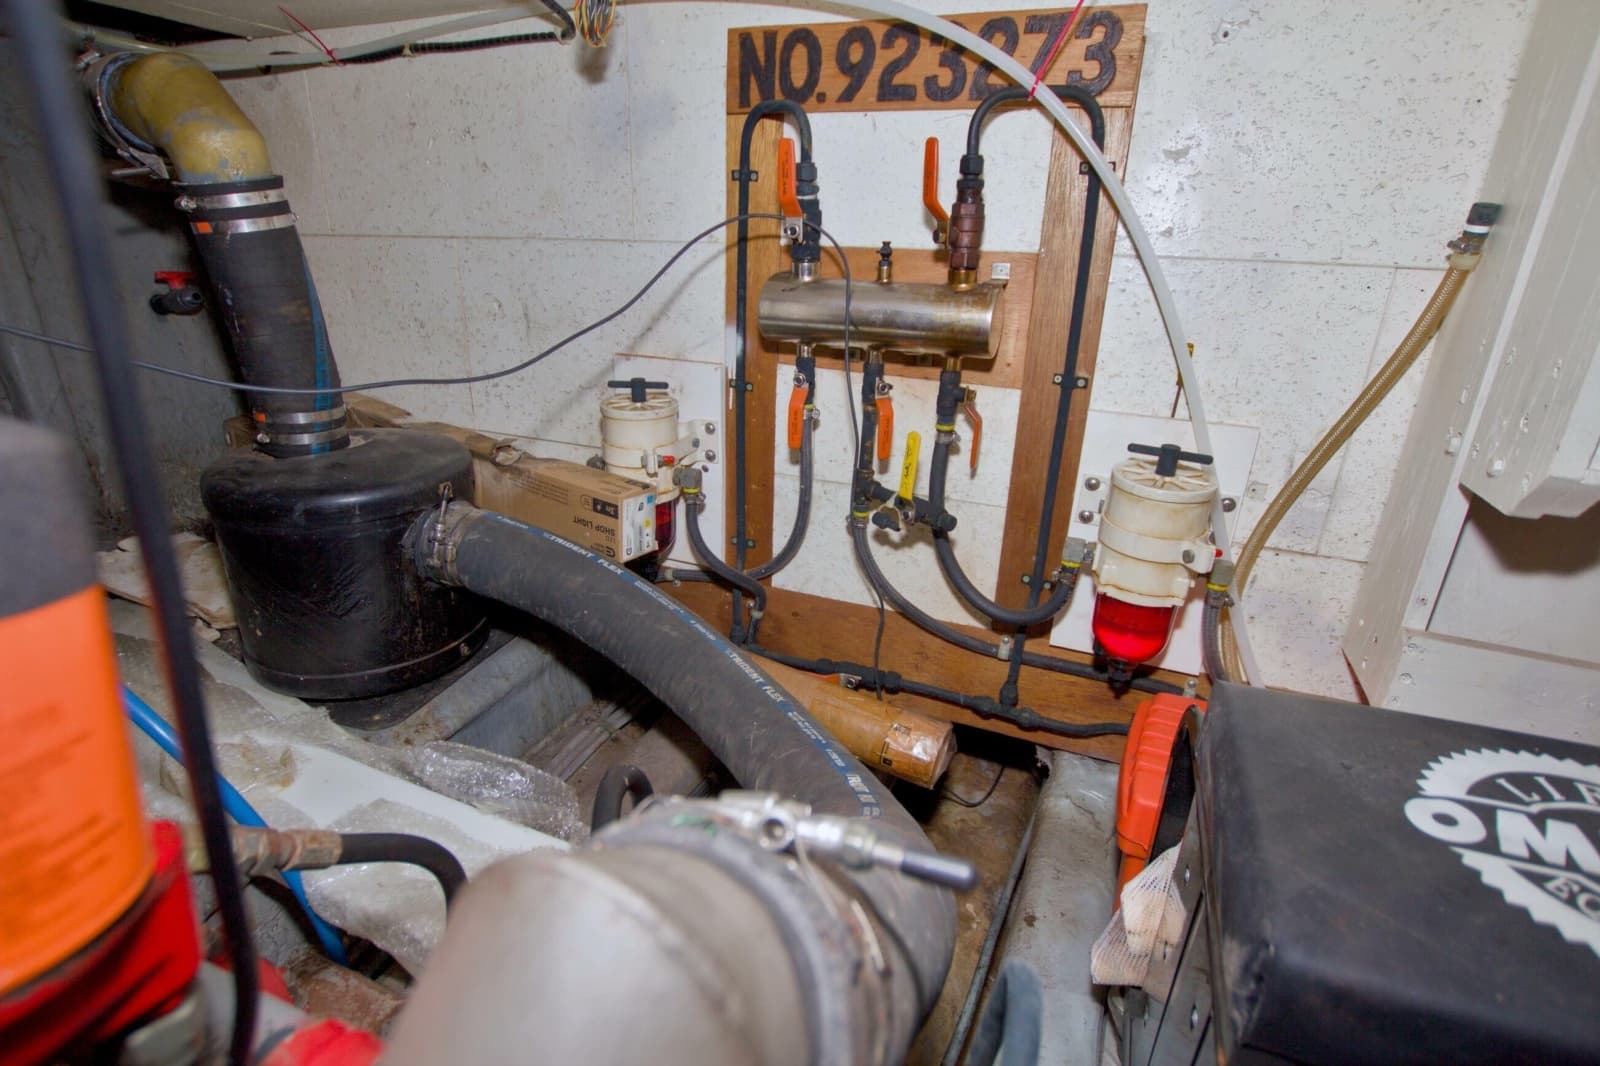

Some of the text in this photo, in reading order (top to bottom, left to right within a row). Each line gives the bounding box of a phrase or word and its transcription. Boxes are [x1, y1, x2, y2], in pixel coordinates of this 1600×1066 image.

[573, 515, 616, 537] SHOP LIGHT
[550, 536, 594, 559] TRIDENT
[597, 559, 625, 575] FLEX
[729, 654, 786, 702] TRIDENT FLEX
